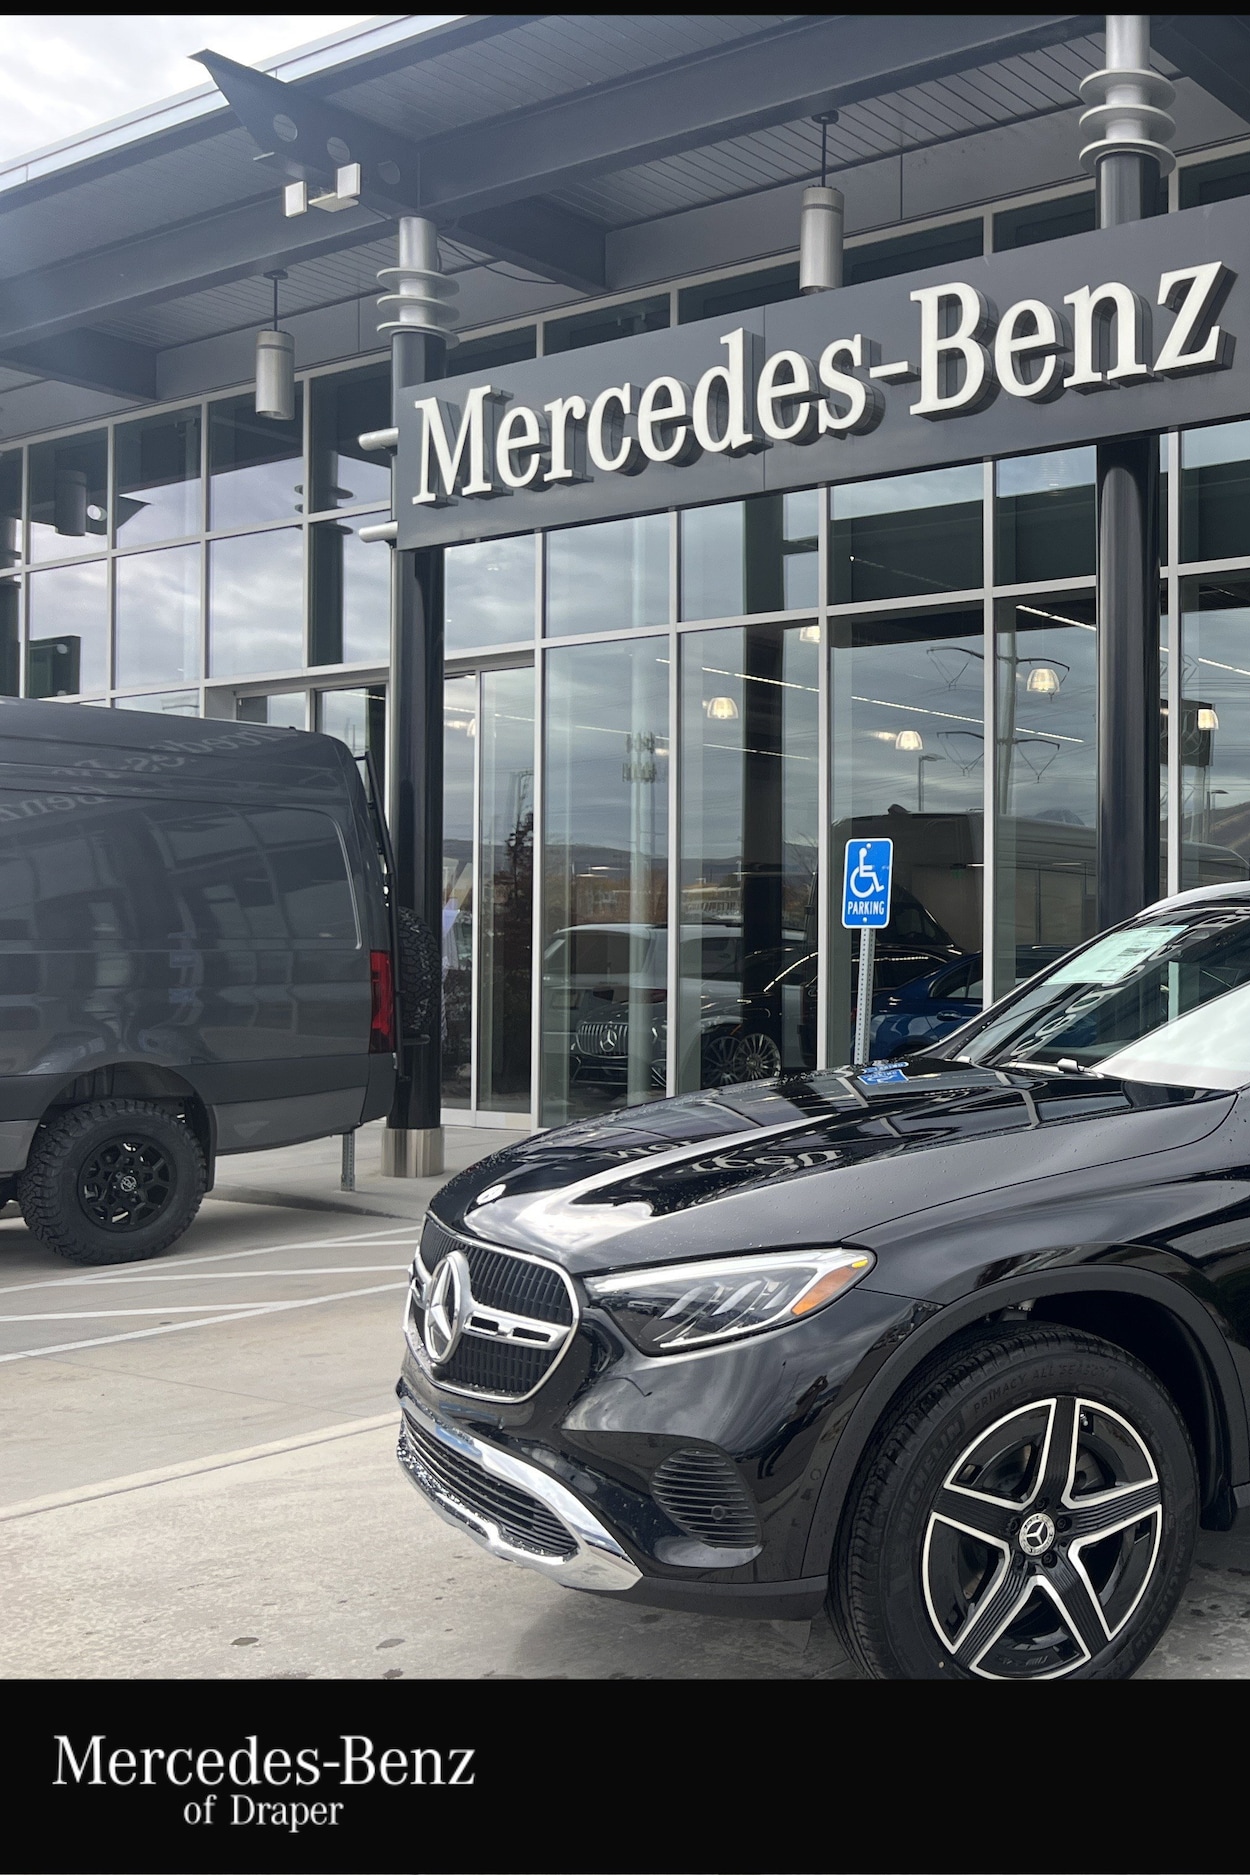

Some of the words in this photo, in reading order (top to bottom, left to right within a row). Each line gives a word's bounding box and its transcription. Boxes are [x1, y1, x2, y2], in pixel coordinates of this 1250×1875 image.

[412, 261, 1226, 507] Mercedes-Benz
[847, 900, 885, 915] PARKING
[974, 1371, 1027, 1413] PRIMACY
[1032, 1364, 1055, 1380] ALL
